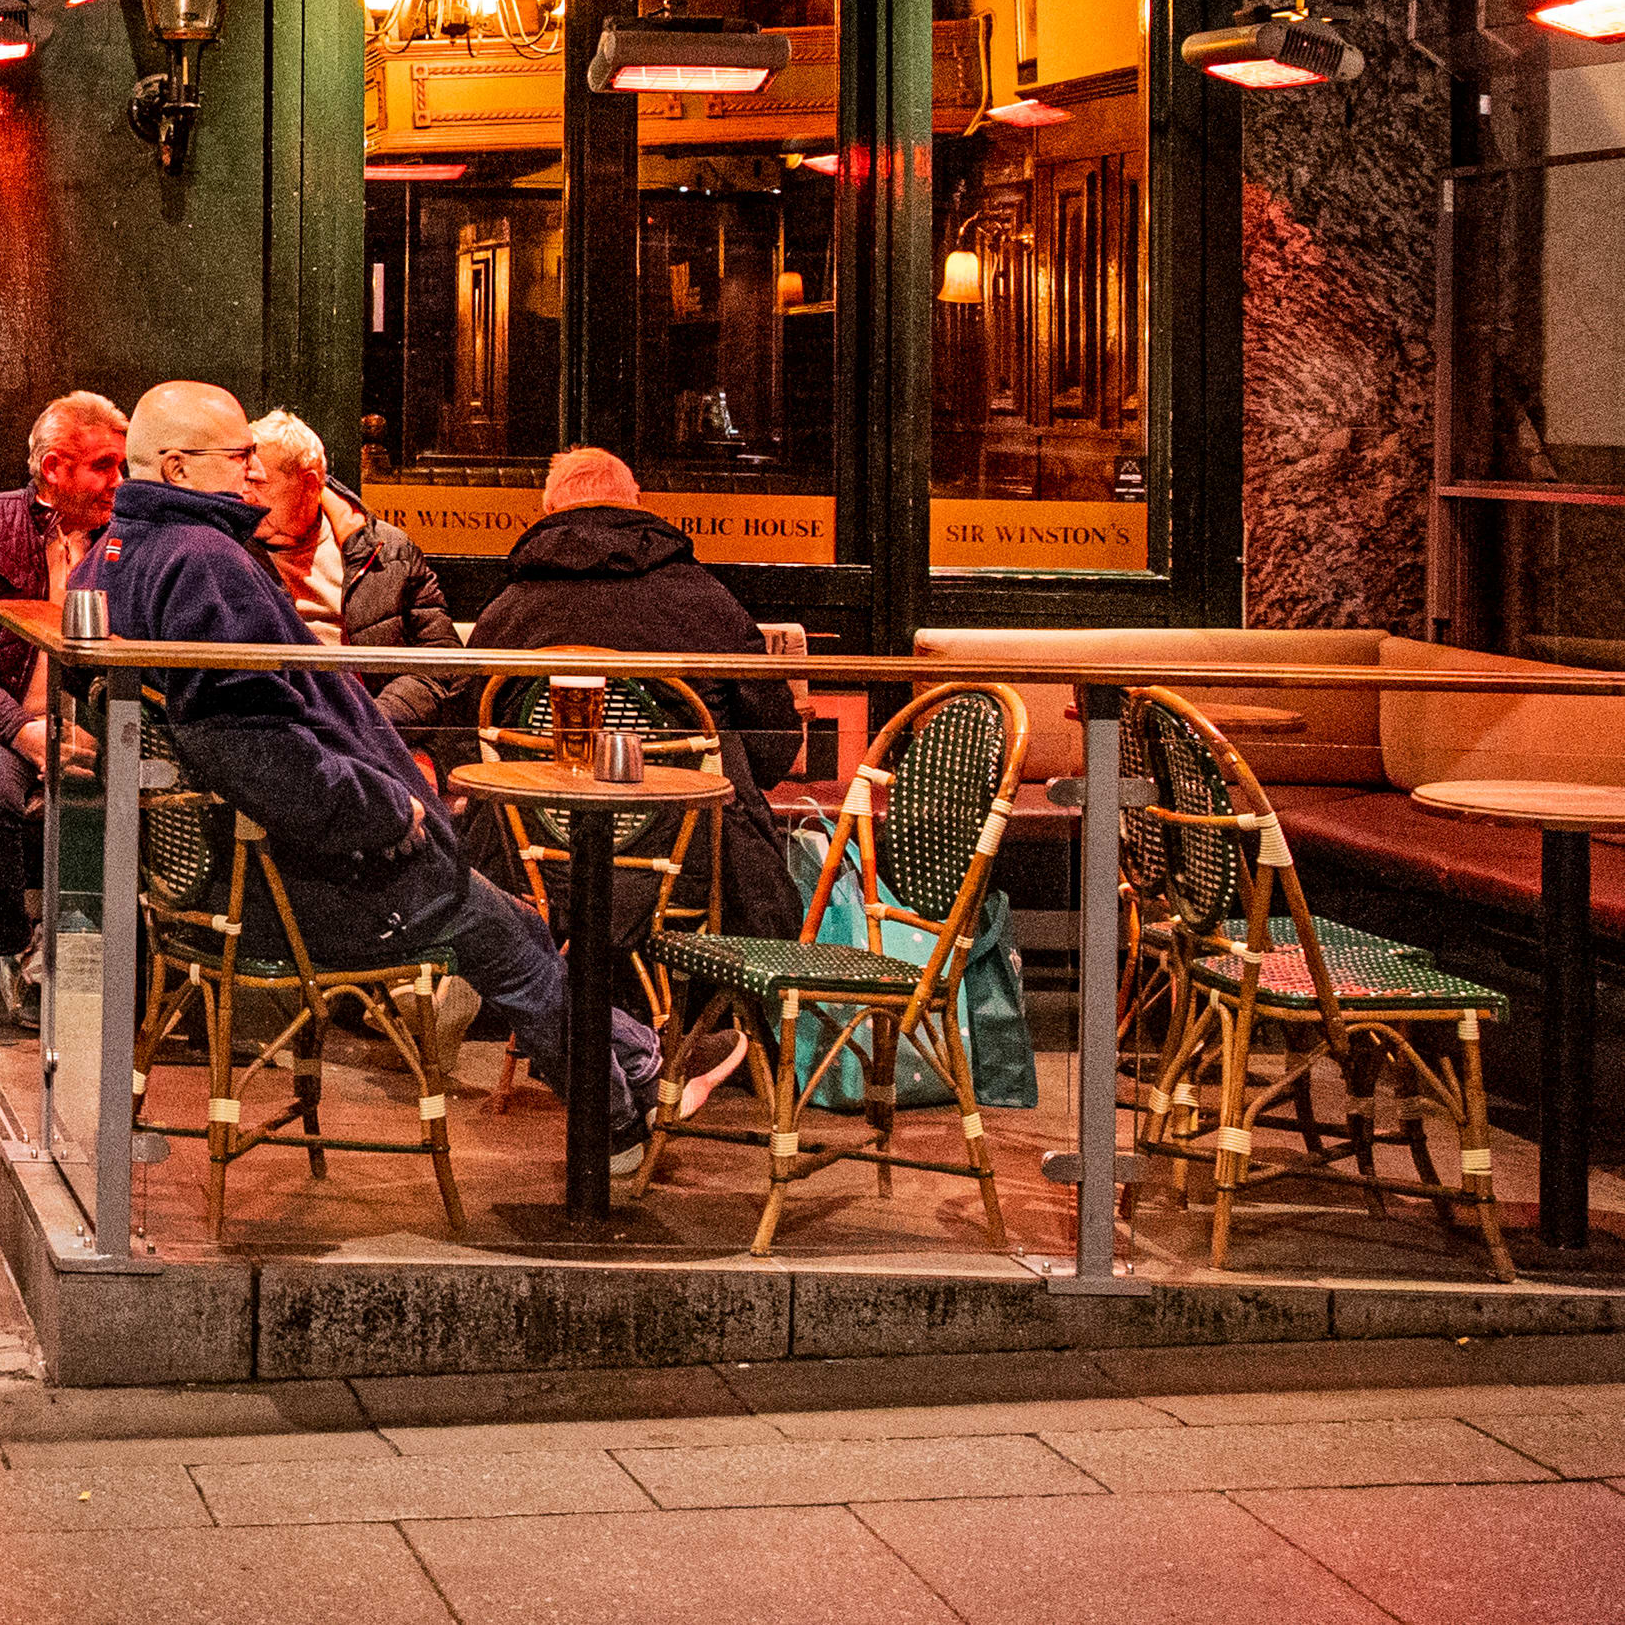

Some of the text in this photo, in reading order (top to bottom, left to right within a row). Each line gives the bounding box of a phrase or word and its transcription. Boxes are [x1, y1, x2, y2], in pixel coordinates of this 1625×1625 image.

[744, 517, 824, 537] HOUSE
[946, 523, 1130, 545] SIR WINSTON'S
